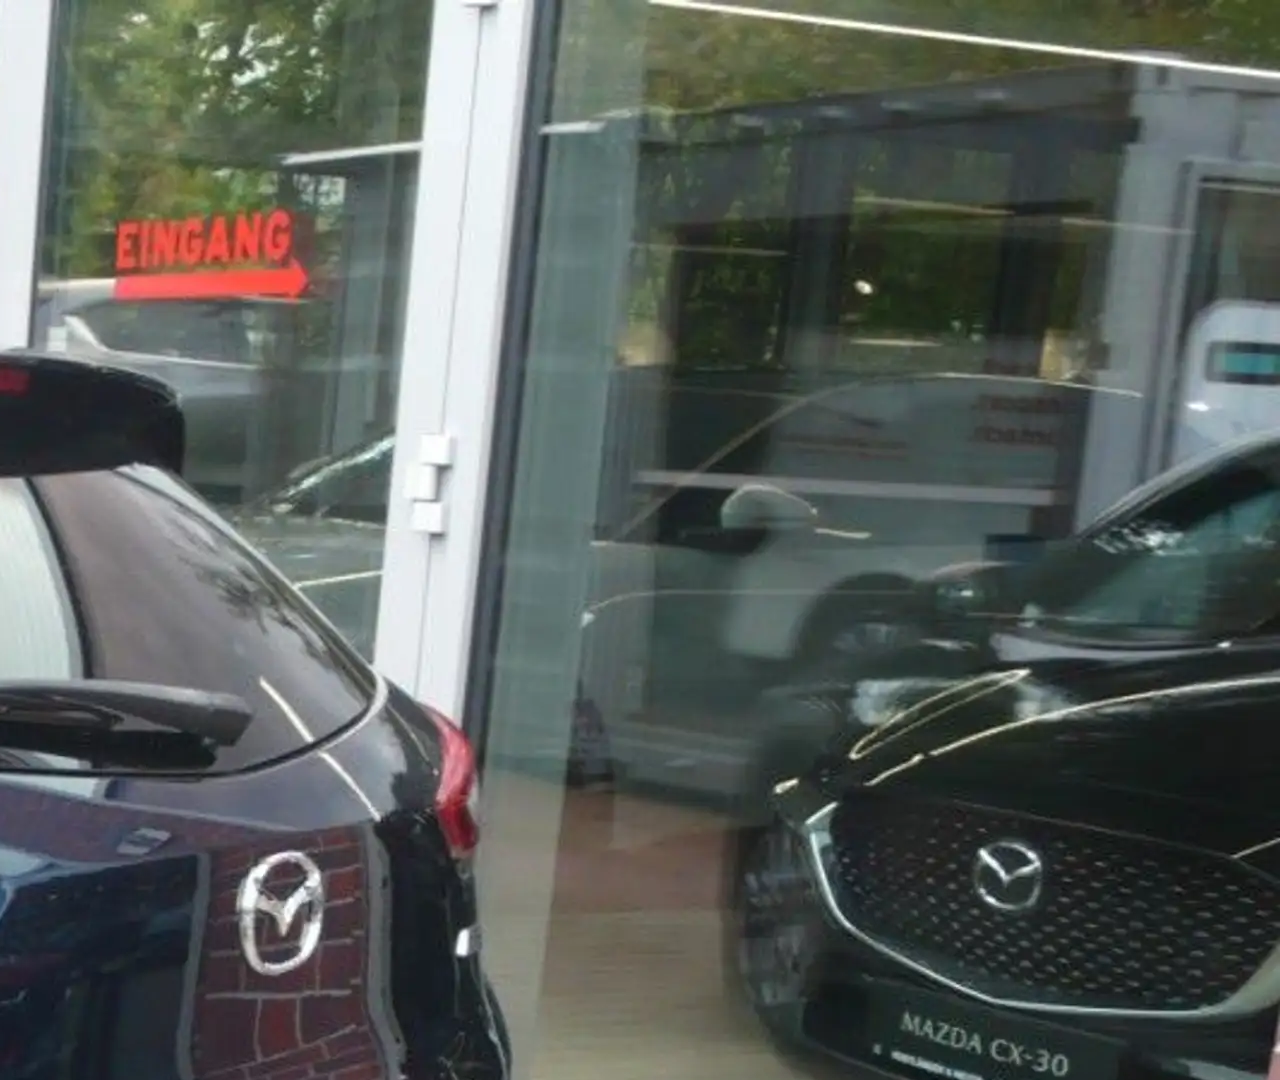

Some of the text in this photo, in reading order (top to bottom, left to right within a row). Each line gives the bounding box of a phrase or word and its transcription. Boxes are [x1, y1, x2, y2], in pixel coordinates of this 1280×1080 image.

[115, 208, 292, 269] EINGANG
[900, 1011, 1069, 1077] MAZDA CX-30
